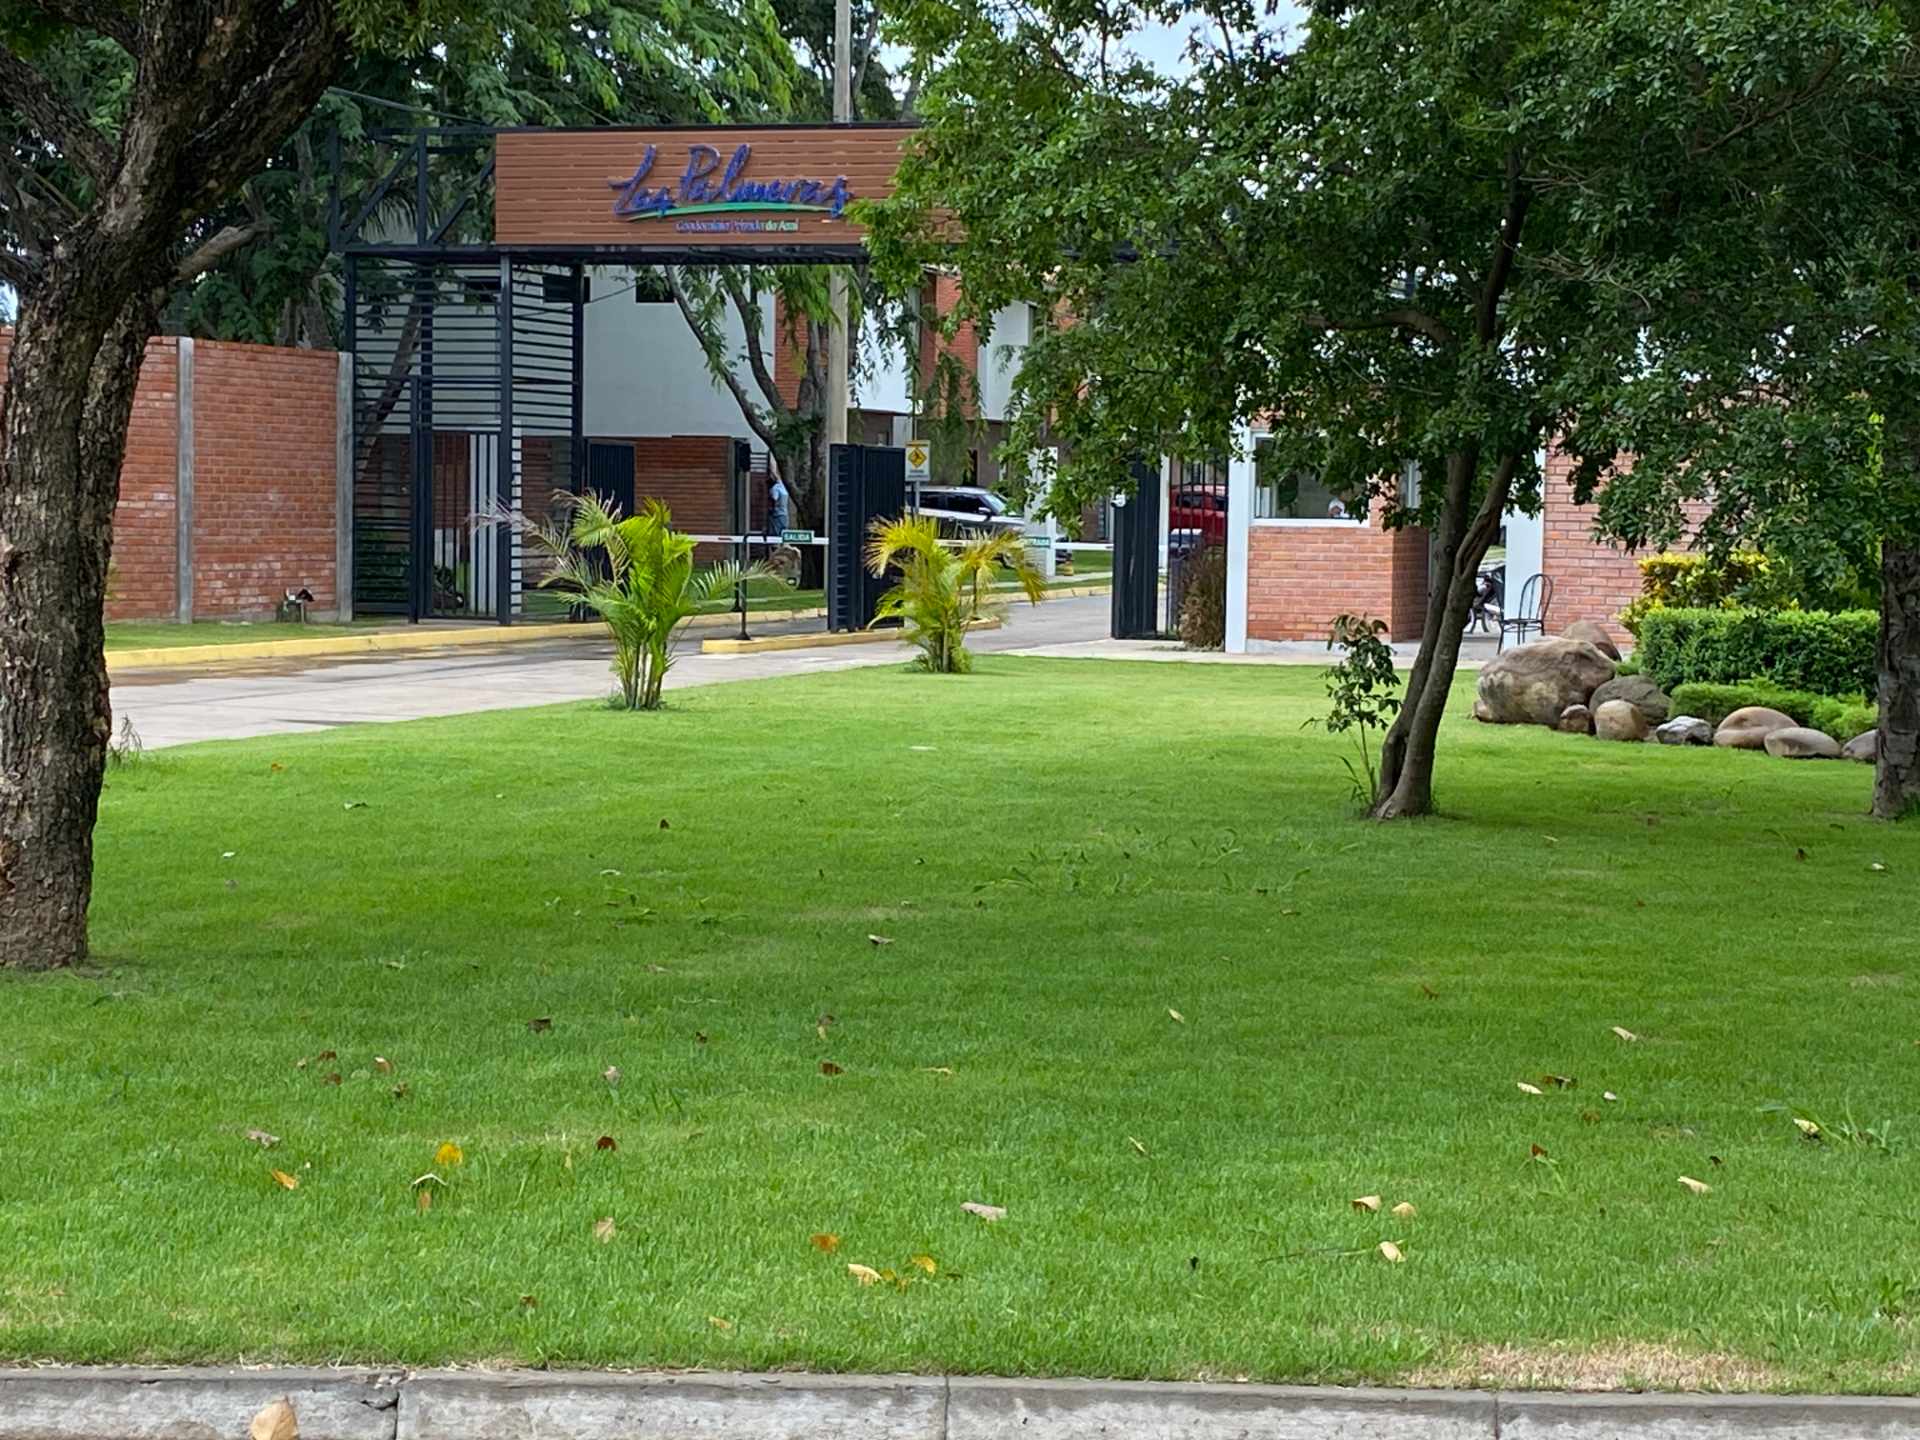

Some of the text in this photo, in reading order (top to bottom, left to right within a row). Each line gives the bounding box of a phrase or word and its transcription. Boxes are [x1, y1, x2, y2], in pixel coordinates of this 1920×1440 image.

[609, 143, 854, 218] Las Palmeras
[784, 533, 810, 541] SALIDA
